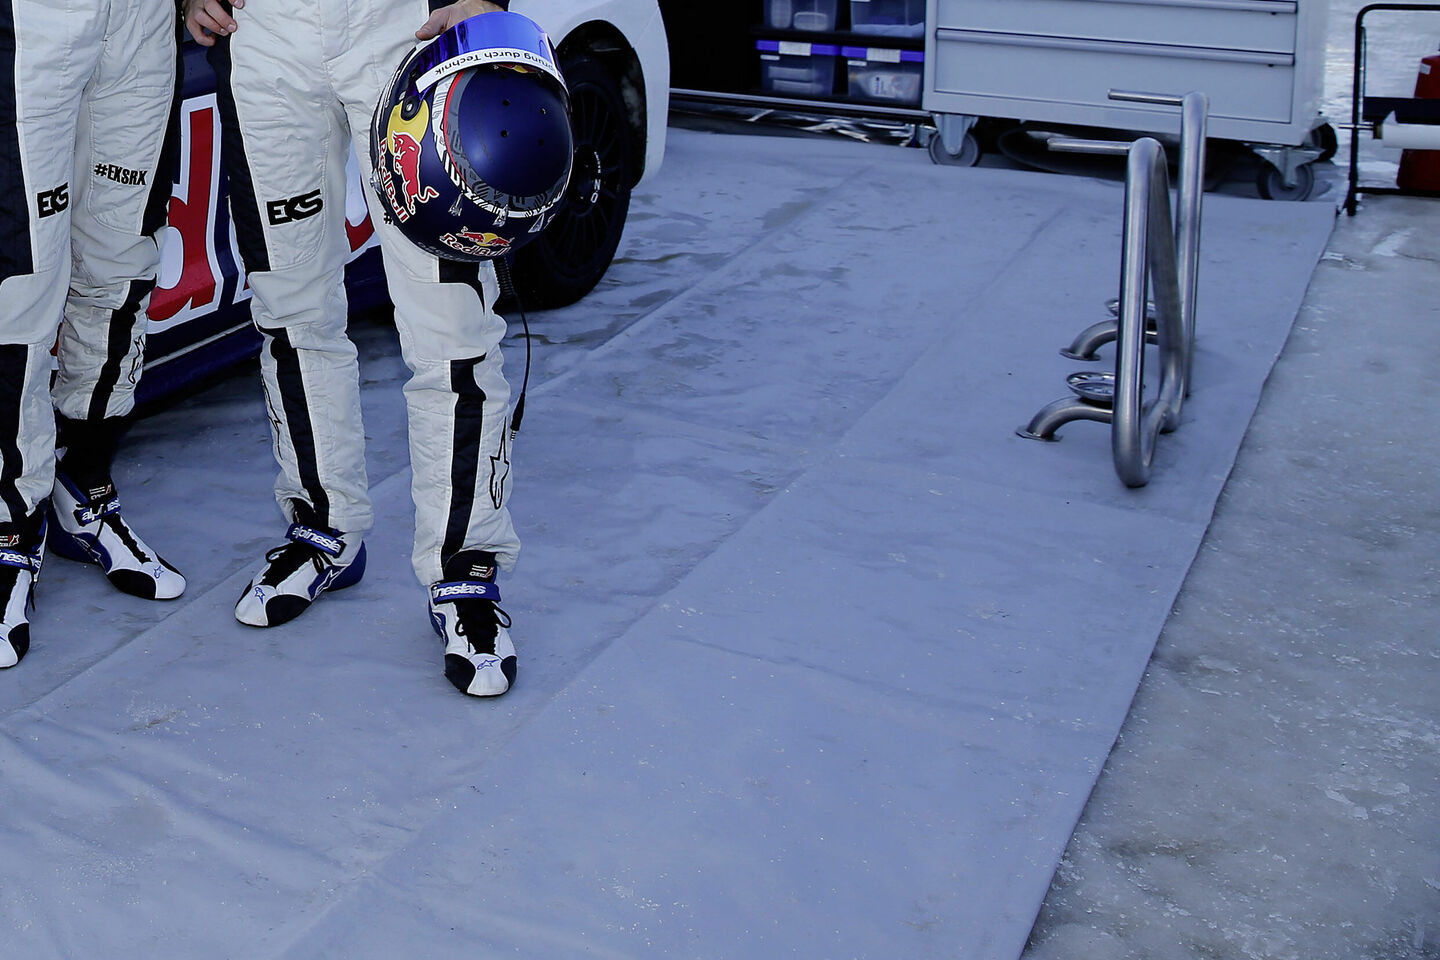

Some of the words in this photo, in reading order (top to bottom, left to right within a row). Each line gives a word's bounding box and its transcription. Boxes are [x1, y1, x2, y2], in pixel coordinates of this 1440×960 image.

[434, 55, 482, 76] Technik
[483, 50, 521, 60] durch
[94, 163, 148, 186] #EKSRX
[440, 232, 476, 256] Red
